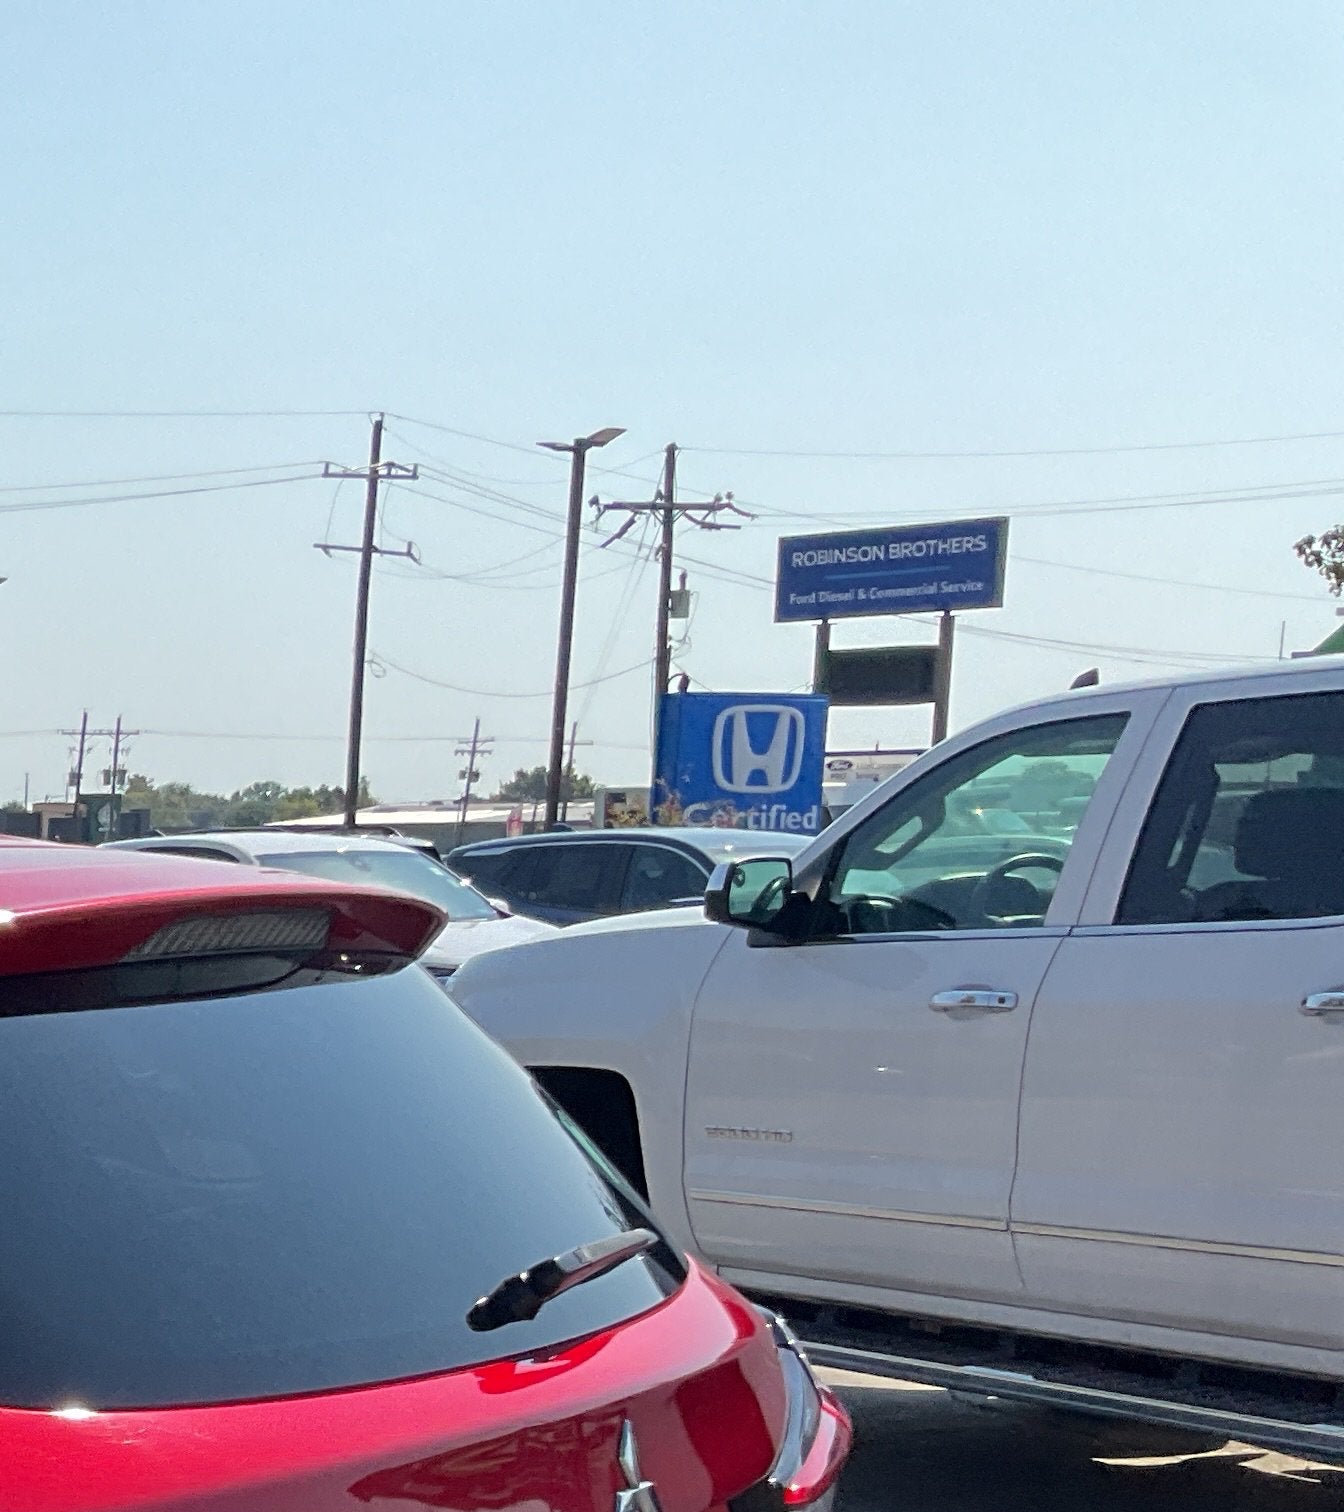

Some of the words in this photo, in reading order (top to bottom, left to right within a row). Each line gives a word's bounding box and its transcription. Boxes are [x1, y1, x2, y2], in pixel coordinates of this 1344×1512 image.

[791, 543, 886, 567] ROBINSON
[888, 535, 987, 559] BROTHERS
[941, 579, 985, 595] Service
